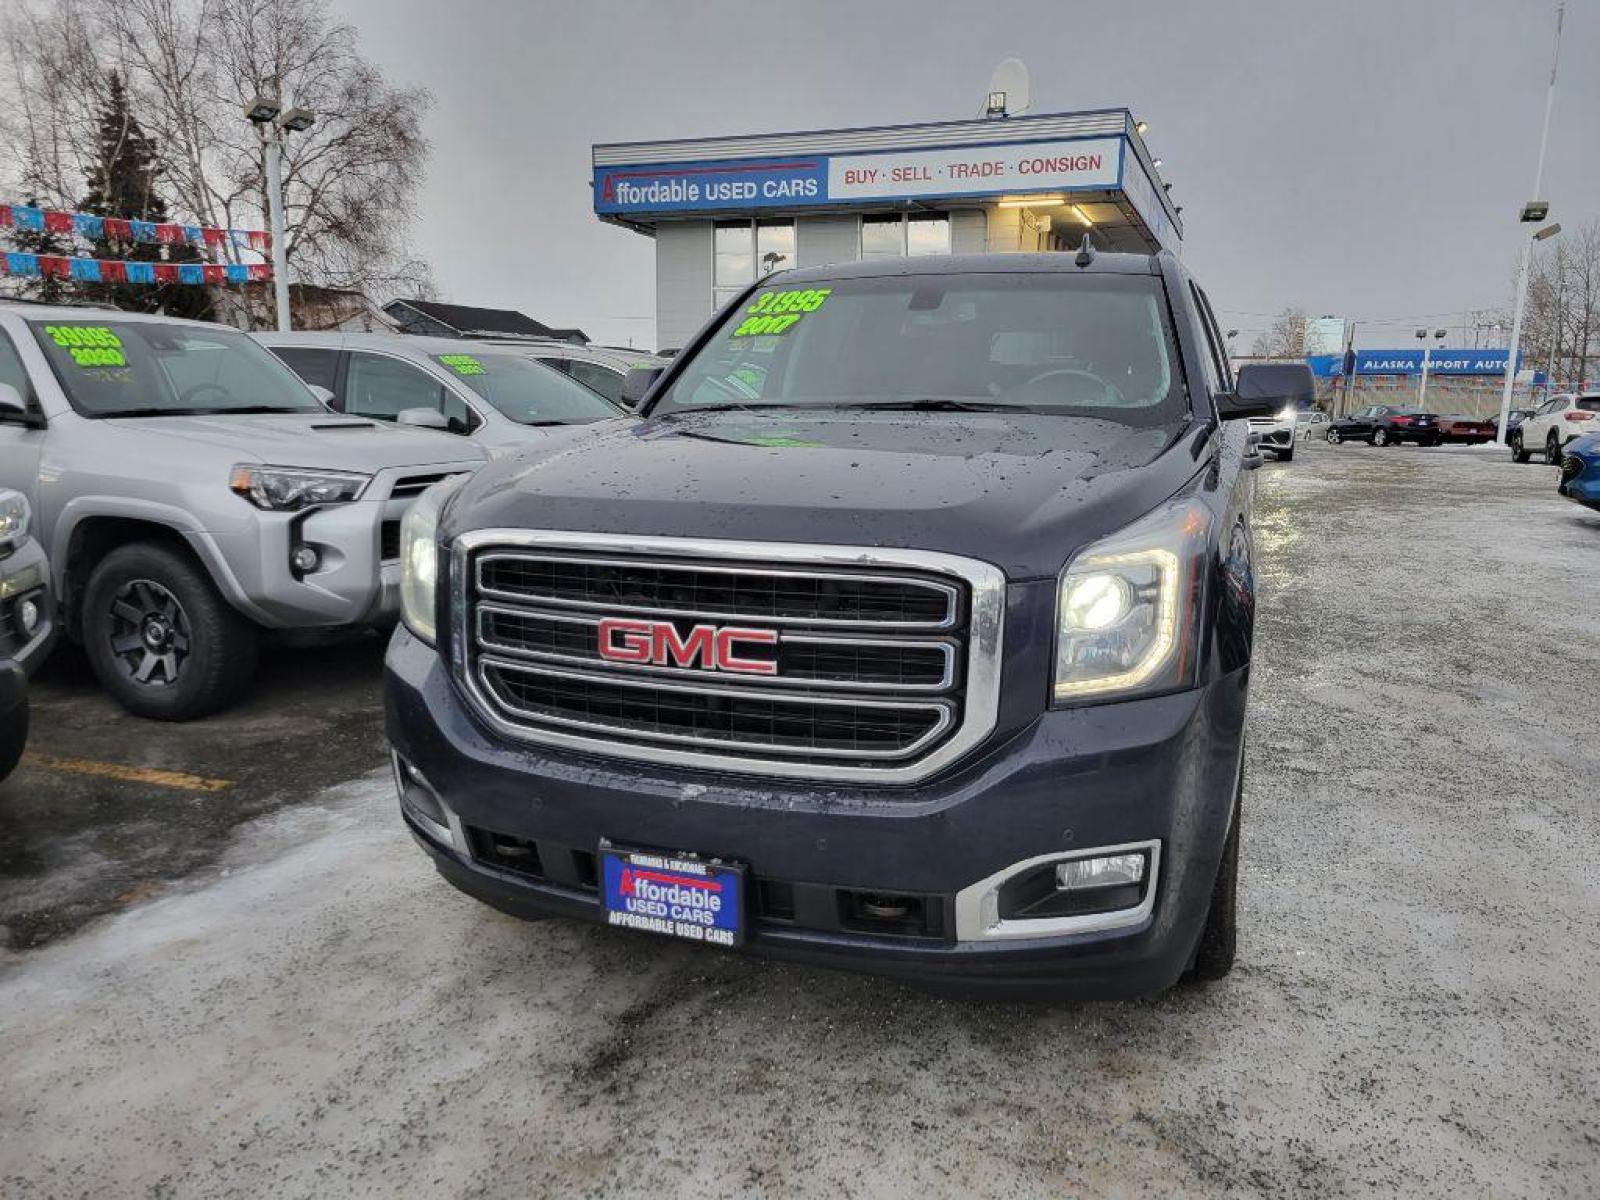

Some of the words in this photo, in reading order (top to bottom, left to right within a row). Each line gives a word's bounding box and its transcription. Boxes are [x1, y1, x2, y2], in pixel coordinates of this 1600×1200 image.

[844, 169, 878, 185] BUY
[891, 166, 932, 182] SELL
[946, 161, 1004, 180] TRADE
[1018, 154, 1102, 175] CONSIGN
[602, 174, 700, 204] Affordable
[705, 182, 758, 201] USED
[763, 178, 818, 198] CARS
[747, 288, 832, 313] 31995
[45, 326, 121, 347] 39995
[734, 313, 801, 336] 2017
[70, 348, 126, 366] 2020
[1363, 359, 1415, 370] ALASKA
[599, 617, 778, 676] GMC
[619, 867, 721, 912] Affordable
[626, 897, 668, 918] USED
[671, 905, 715, 926] CARS
[608, 911, 674, 935] AFFORDABLE
[675, 923, 703, 940] USED
[705, 928, 734, 946] CARS
